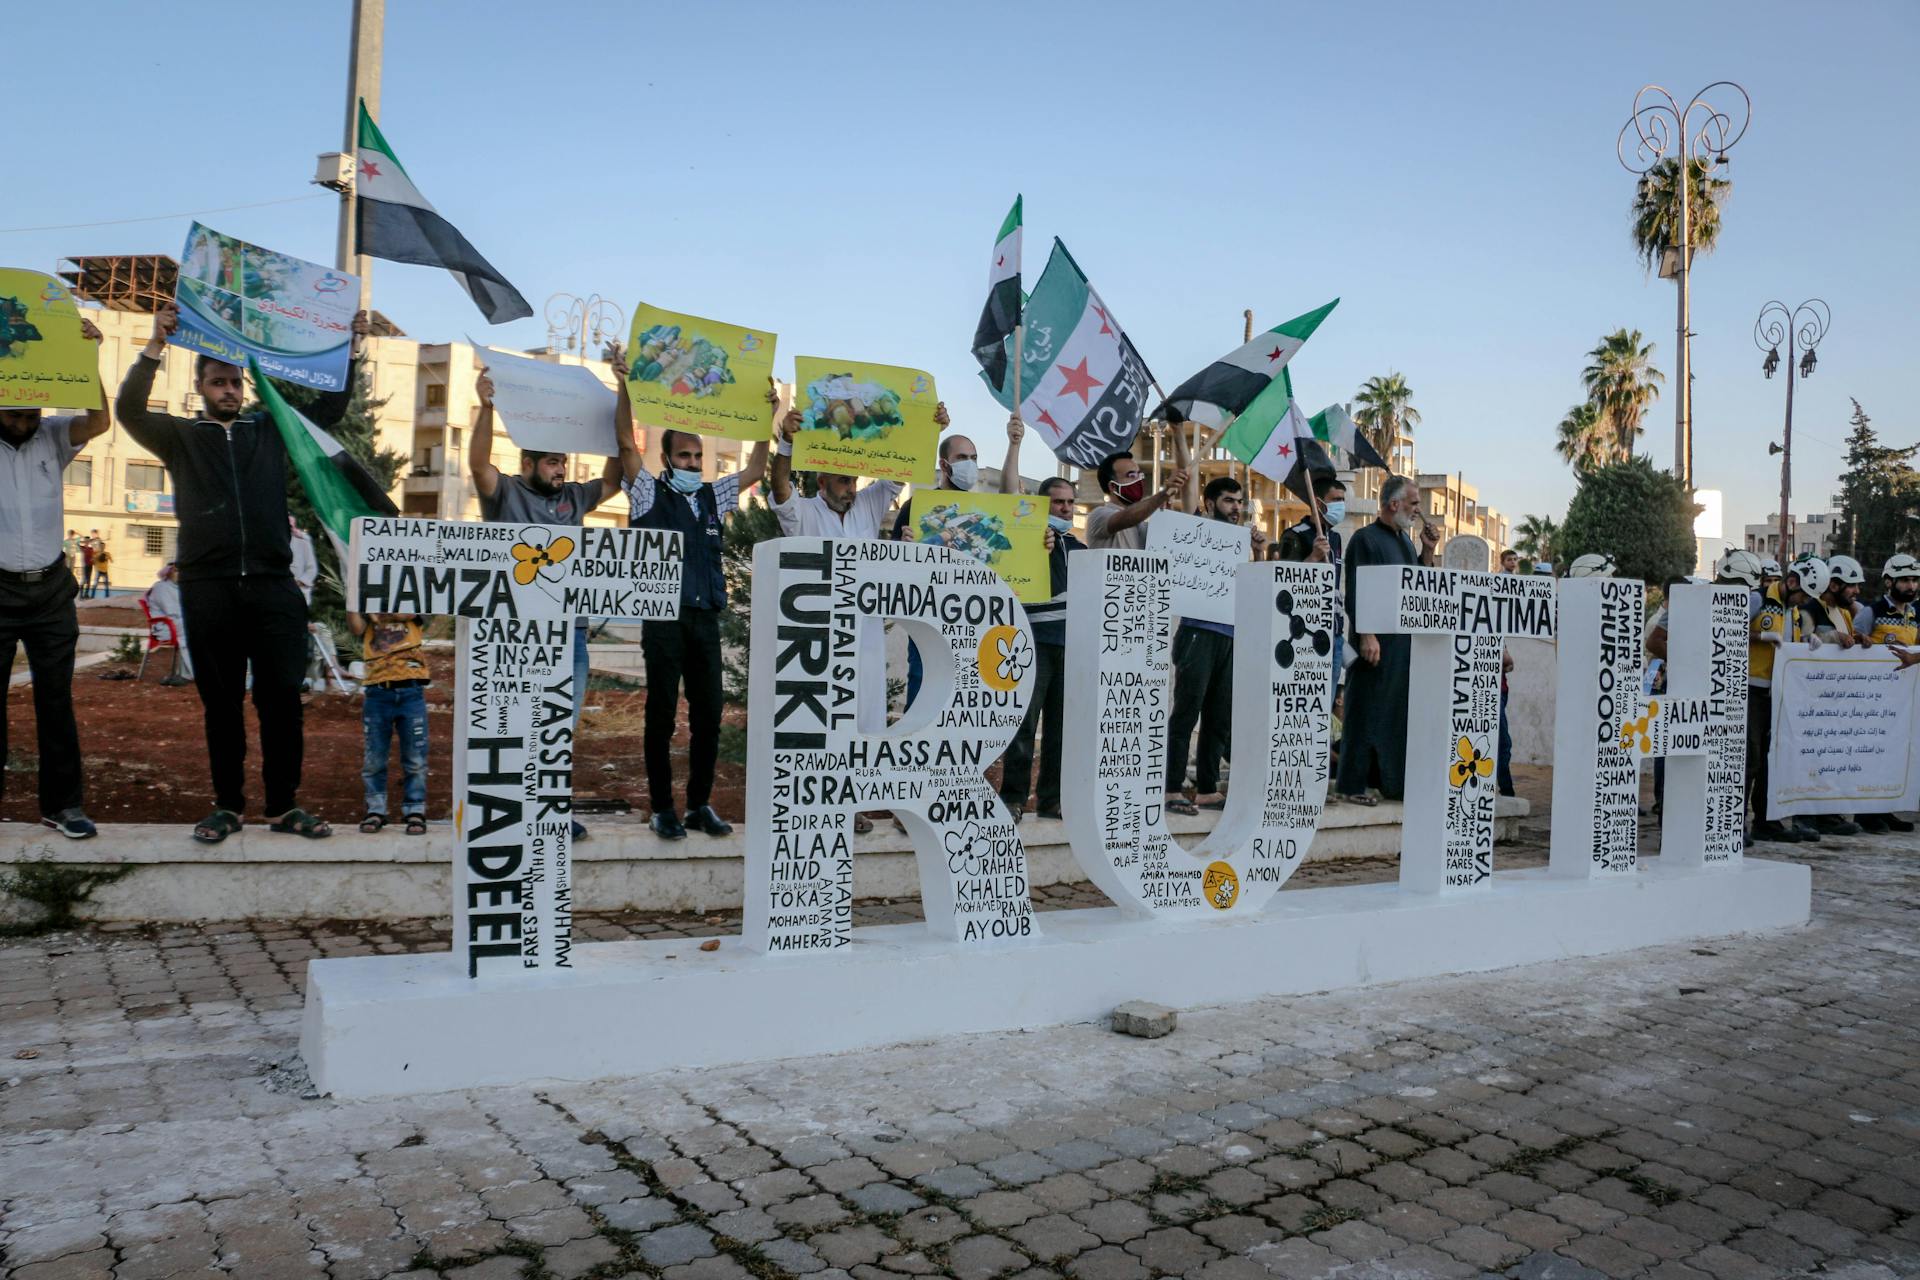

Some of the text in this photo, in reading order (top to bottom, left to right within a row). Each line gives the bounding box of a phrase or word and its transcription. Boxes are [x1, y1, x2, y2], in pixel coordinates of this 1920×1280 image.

[362, 518, 436, 538] RAHAF
[438, 524, 474, 541] NAJIB
[476, 527, 515, 542] FARES
[580, 527, 684, 562] FATIMA
[859, 542, 951, 564] ABDULLAH
[367, 547, 418, 563] SARAH
[443, 546, 489, 563] WALID
[834, 543, 856, 609] SHAM
[930, 569, 996, 586] ALI HAYAN
[1275, 566, 1318, 583] RAHAF
[1401, 567, 1457, 597] RAHAF
[359, 563, 518, 618] HAMZA
[631, 581, 680, 595] YOUSSEF
[1493, 576, 1526, 597] SARA
[1525, 580, 1551, 589] FATIMA
[563, 588, 632, 615] MALAK
[631, 599, 675, 617] SANA
[857, 581, 937, 618] GHADA
[1712, 592, 1748, 608] AHMED
[940, 593, 1015, 626] GORI
[1460, 591, 1553, 636] FATIMA
[1102, 584, 1121, 655] NOUR
[1423, 615, 1457, 631] DIRAR
[1617, 583, 1632, 659] SAMER
[1632, 584, 1642, 669] MOHAMED
[474, 619, 568, 646] SARAH
[774, 540, 834, 749] TURKI
[496, 644, 563, 667] INSAF
[1597, 581, 1618, 744] SHUROOQ
[493, 664, 525, 678] ALI
[1100, 672, 1143, 687] NADA
[1293, 671, 1328, 681] BATOUL
[1452, 635, 1472, 716] DALAL
[1709, 626, 1726, 716] SARAH
[471, 643, 489, 730] MARAM
[1471, 675, 1498, 689] ASIA
[1624, 683, 1640, 692] OLA
[952, 690, 1023, 709] ABDUL
[1106, 688, 1160, 706] ANAS
[1276, 697, 1324, 713] ISRA
[532, 696, 541, 728] DIRAR
[936, 710, 997, 728] JAMILA
[1102, 707, 1141, 719] AMER
[1670, 700, 1709, 723] ALAA
[1100, 721, 1142, 734] KHETAM
[1273, 714, 1310, 730] JANA
[1452, 718, 1490, 734] WALID
[1703, 724, 1728, 737] AMON
[536, 675, 573, 822] YASSER
[1101, 736, 1142, 753] ALAA
[1271, 732, 1312, 748] SARAH
[1671, 733, 1699, 750] JOUD
[794, 753, 848, 771] RAWDA
[849, 740, 983, 769] HASSAN
[1100, 754, 1142, 767] AHMED
[1597, 756, 1633, 768] RAWDA
[855, 768, 882, 777] RUBA
[1098, 766, 1142, 779] HASSAN
[1145, 709, 1165, 826] SHAHEED
[1707, 761, 1721, 770] OLA
[1268, 770, 1302, 789] JANA
[1602, 770, 1636, 786] SHAM
[1707, 771, 1741, 784] NIHAD
[772, 753, 791, 833] SARAH
[794, 775, 857, 805] ISRA
[855, 780, 922, 801] YAMEN
[936, 788, 970, 802] AMER
[1267, 789, 1305, 802] SARAH
[1482, 784, 1495, 793] AYA
[1602, 792, 1637, 806] FATIMA
[1105, 782, 1120, 841] SARAH
[1263, 811, 1285, 820] NOUR
[1732, 785, 1743, 853] FARES
[791, 814, 845, 830] DIRAR
[981, 825, 1015, 839] SARAH
[1474, 796, 1494, 884] YASSER
[775, 833, 849, 860] ALAA
[1252, 839, 1296, 859] RIAD
[1704, 843, 1730, 852] AMIRA
[467, 736, 523, 979] HADEEL
[1143, 861, 1169, 872] SARA
[771, 860, 820, 881] HIND
[1140, 871, 1165, 880] AMIRA
[1246, 867, 1280, 882] AMON
[957, 876, 1024, 900] KHALED
[770, 890, 819, 909] TOKA
[768, 914, 820, 929] MOHAMED
[964, 919, 1031, 942] AYOUB
[523, 916, 538, 969] FARES
[769, 934, 819, 950] MAHER
